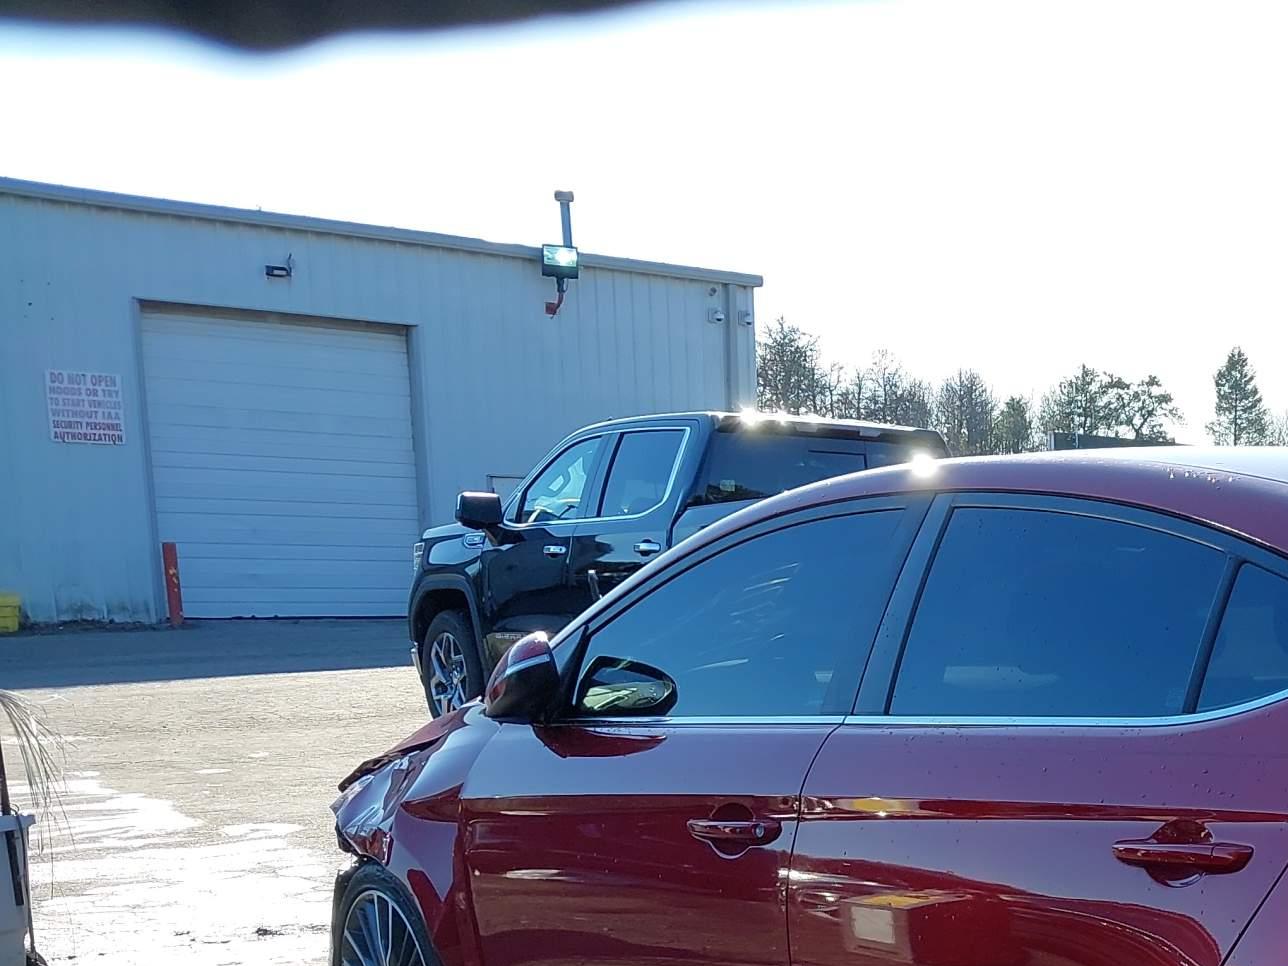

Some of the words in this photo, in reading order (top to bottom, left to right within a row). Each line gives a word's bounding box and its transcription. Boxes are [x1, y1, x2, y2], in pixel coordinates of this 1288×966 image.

[50, 372, 64, 384] DO
[67, 373, 87, 386] NOT
[90, 374, 117, 387] OPEN
[48, 386, 83, 397] HOODS
[85, 387, 99, 397] OR
[101, 388, 119, 399] TRY
[49, 397, 60, 406] TO
[62, 398, 85, 408] START
[87, 399, 121, 410] VEHICLES
[50, 408, 99, 420] WITHOUT
[102, 410, 121, 420] IAA
[52, 419, 83, 430] SECURITY
[86, 421, 123, 432] PERSONNEL
[54, 431, 123, 443] AUTHORIZATION
